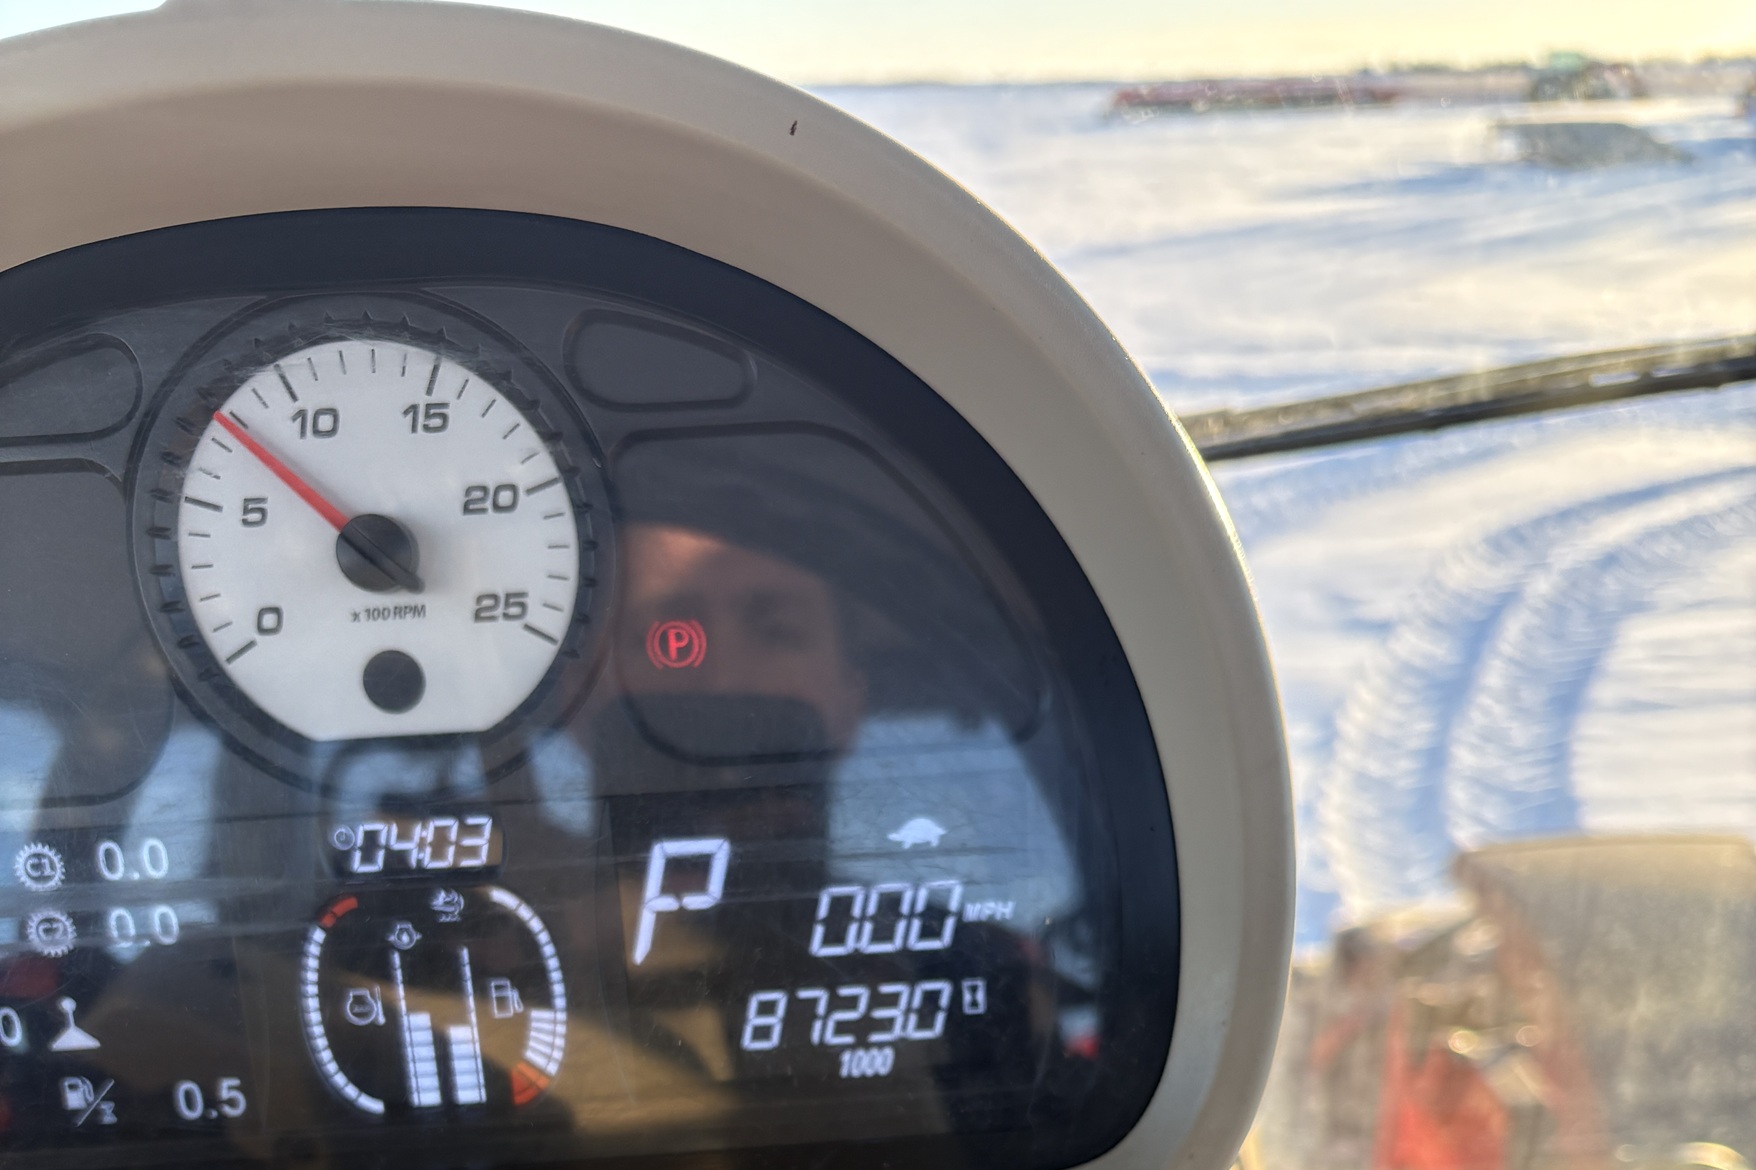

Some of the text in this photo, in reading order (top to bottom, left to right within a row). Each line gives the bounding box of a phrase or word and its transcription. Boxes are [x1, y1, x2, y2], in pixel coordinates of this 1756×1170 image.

[291, 406, 340, 440] 10
[401, 402, 450, 434] 15
[241, 497, 269, 528] 5
[462, 483, 520, 516] 20
[256, 606, 284, 635] 0
[364, 607, 391, 621] 100
[393, 604, 427, 620] RPM
[473, 592, 529, 624] 25
[98, 838, 169, 881] 0.0
[632, 837, 731, 965] P
[962, 901, 1015, 922] MPH
[108, 904, 179, 947] 0.0
[839, 1046, 896, 1079] 1000
[174, 1077, 247, 1120] 0.5
